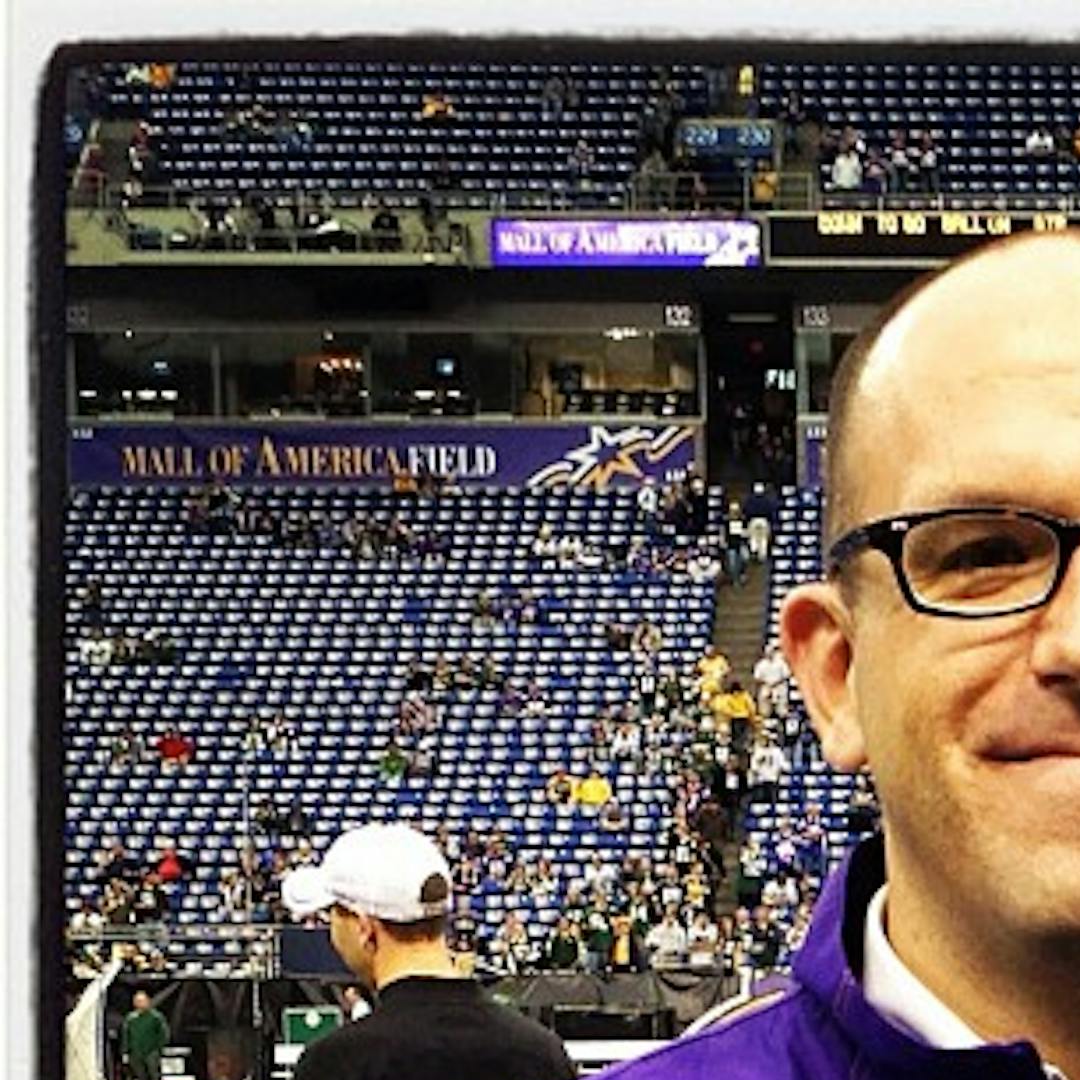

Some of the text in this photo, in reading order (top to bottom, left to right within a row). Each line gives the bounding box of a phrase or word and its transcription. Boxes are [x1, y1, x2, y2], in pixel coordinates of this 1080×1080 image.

[122, 435, 497, 477] MALL OF AMERICA FIELD
